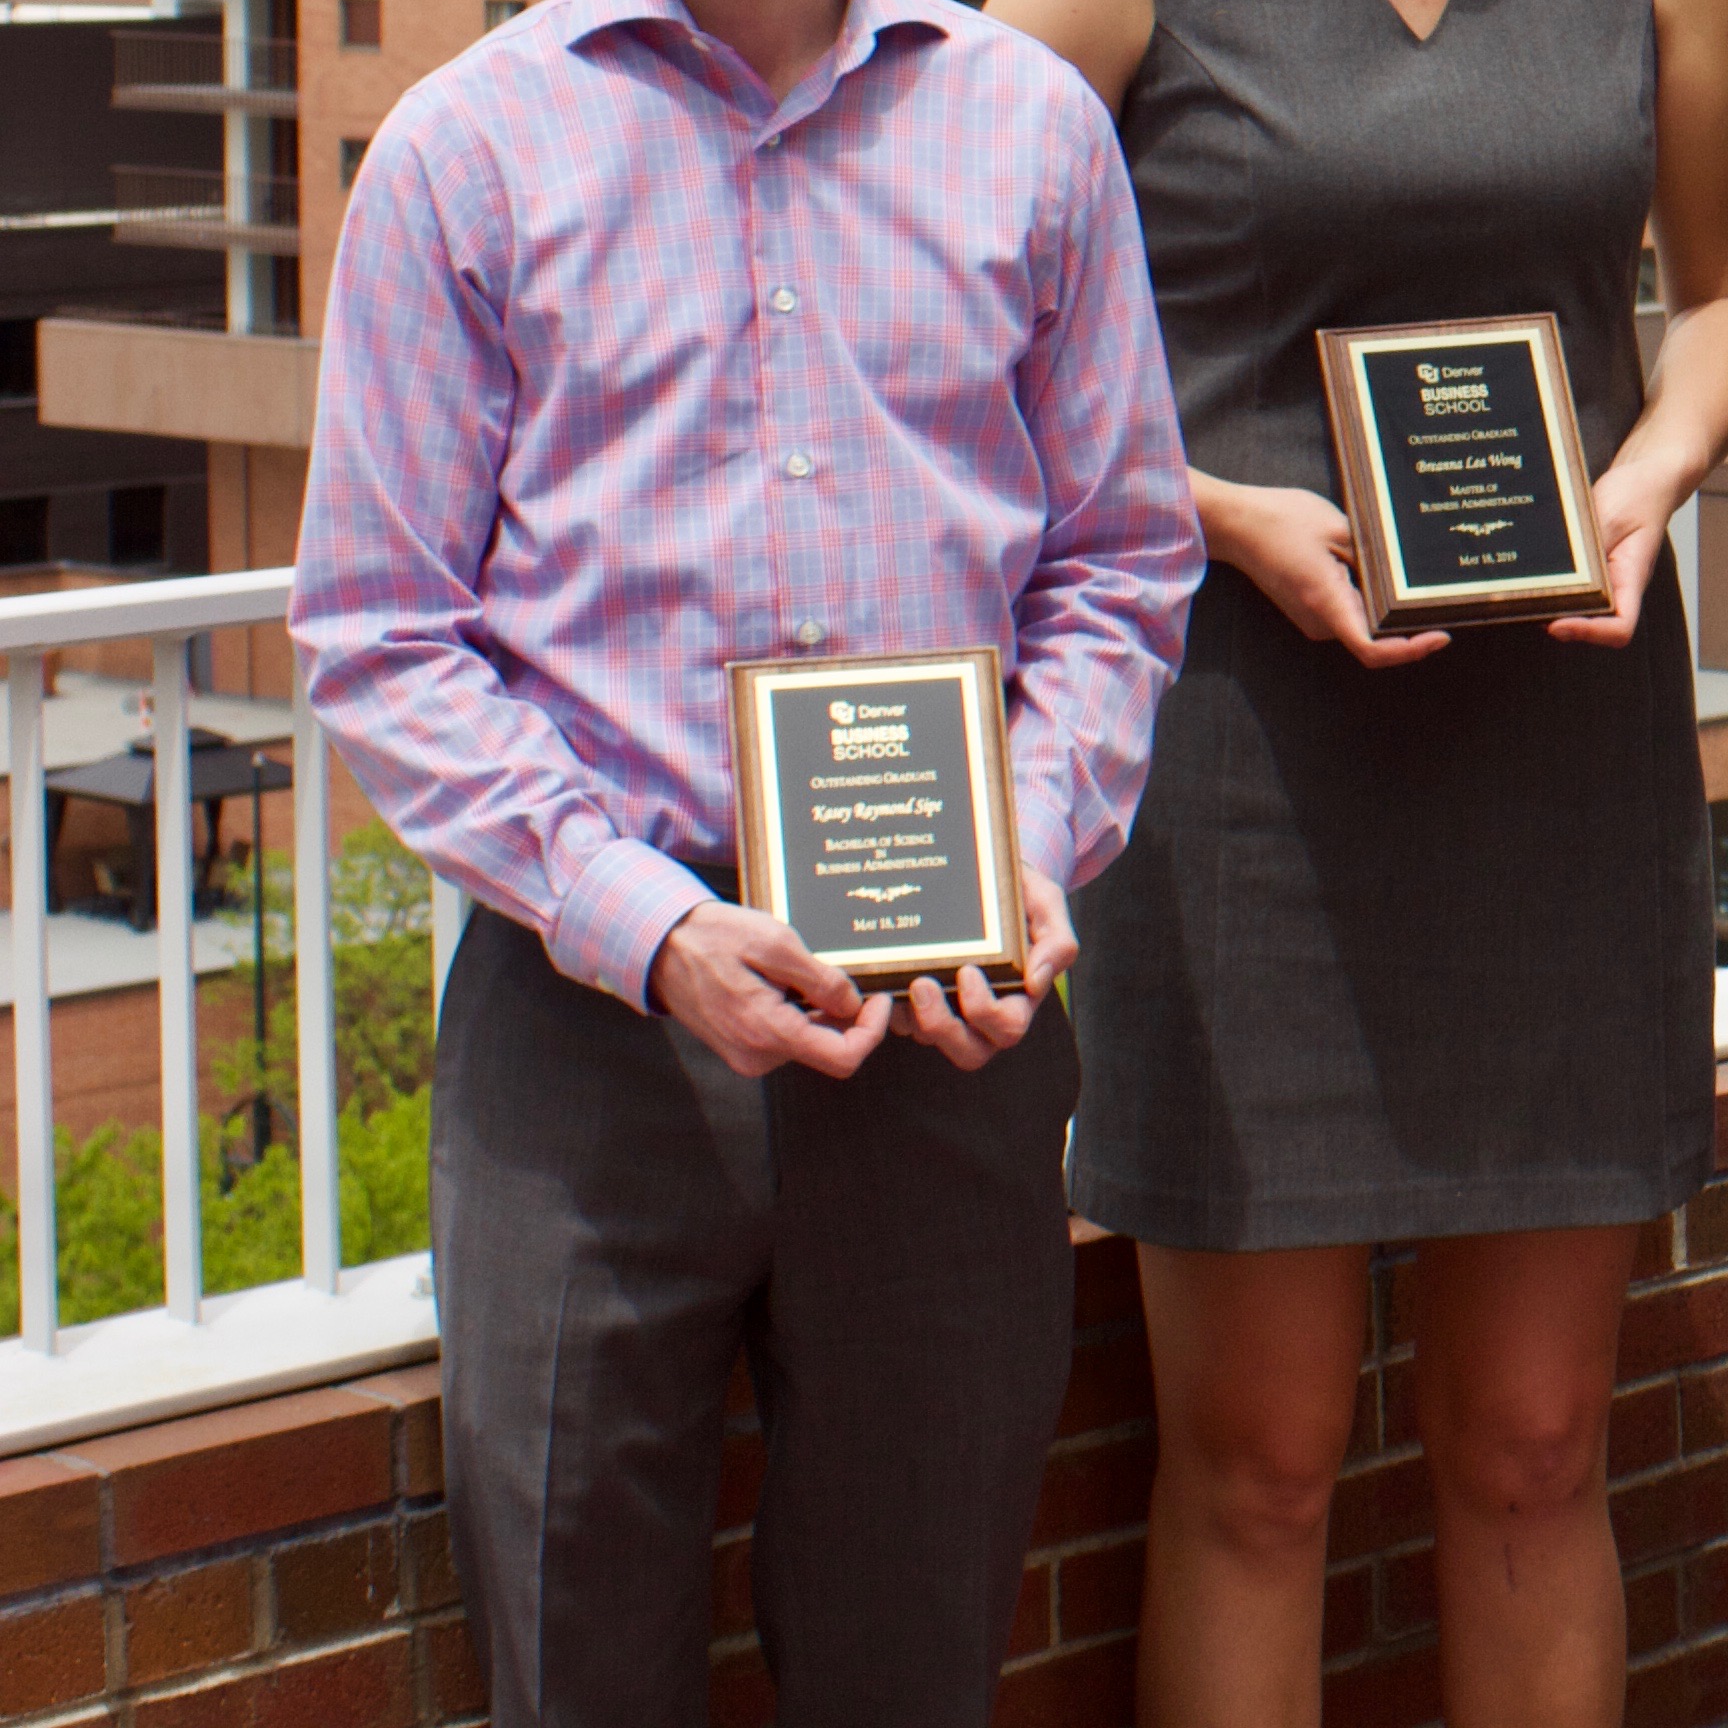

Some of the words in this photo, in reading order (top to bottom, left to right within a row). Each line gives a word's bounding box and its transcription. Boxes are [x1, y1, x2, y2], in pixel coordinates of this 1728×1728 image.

[1441, 364, 1484, 379] Denver
[1420, 383, 1488, 402] BUSINESS
[1423, 399, 1491, 416] SCHOOL
[1487, 451, 1523, 470] Wong
[858, 703, 907, 720] Denver
[831, 724, 909, 745] BUSINESS
[833, 742, 910, 762] SCHOOL
